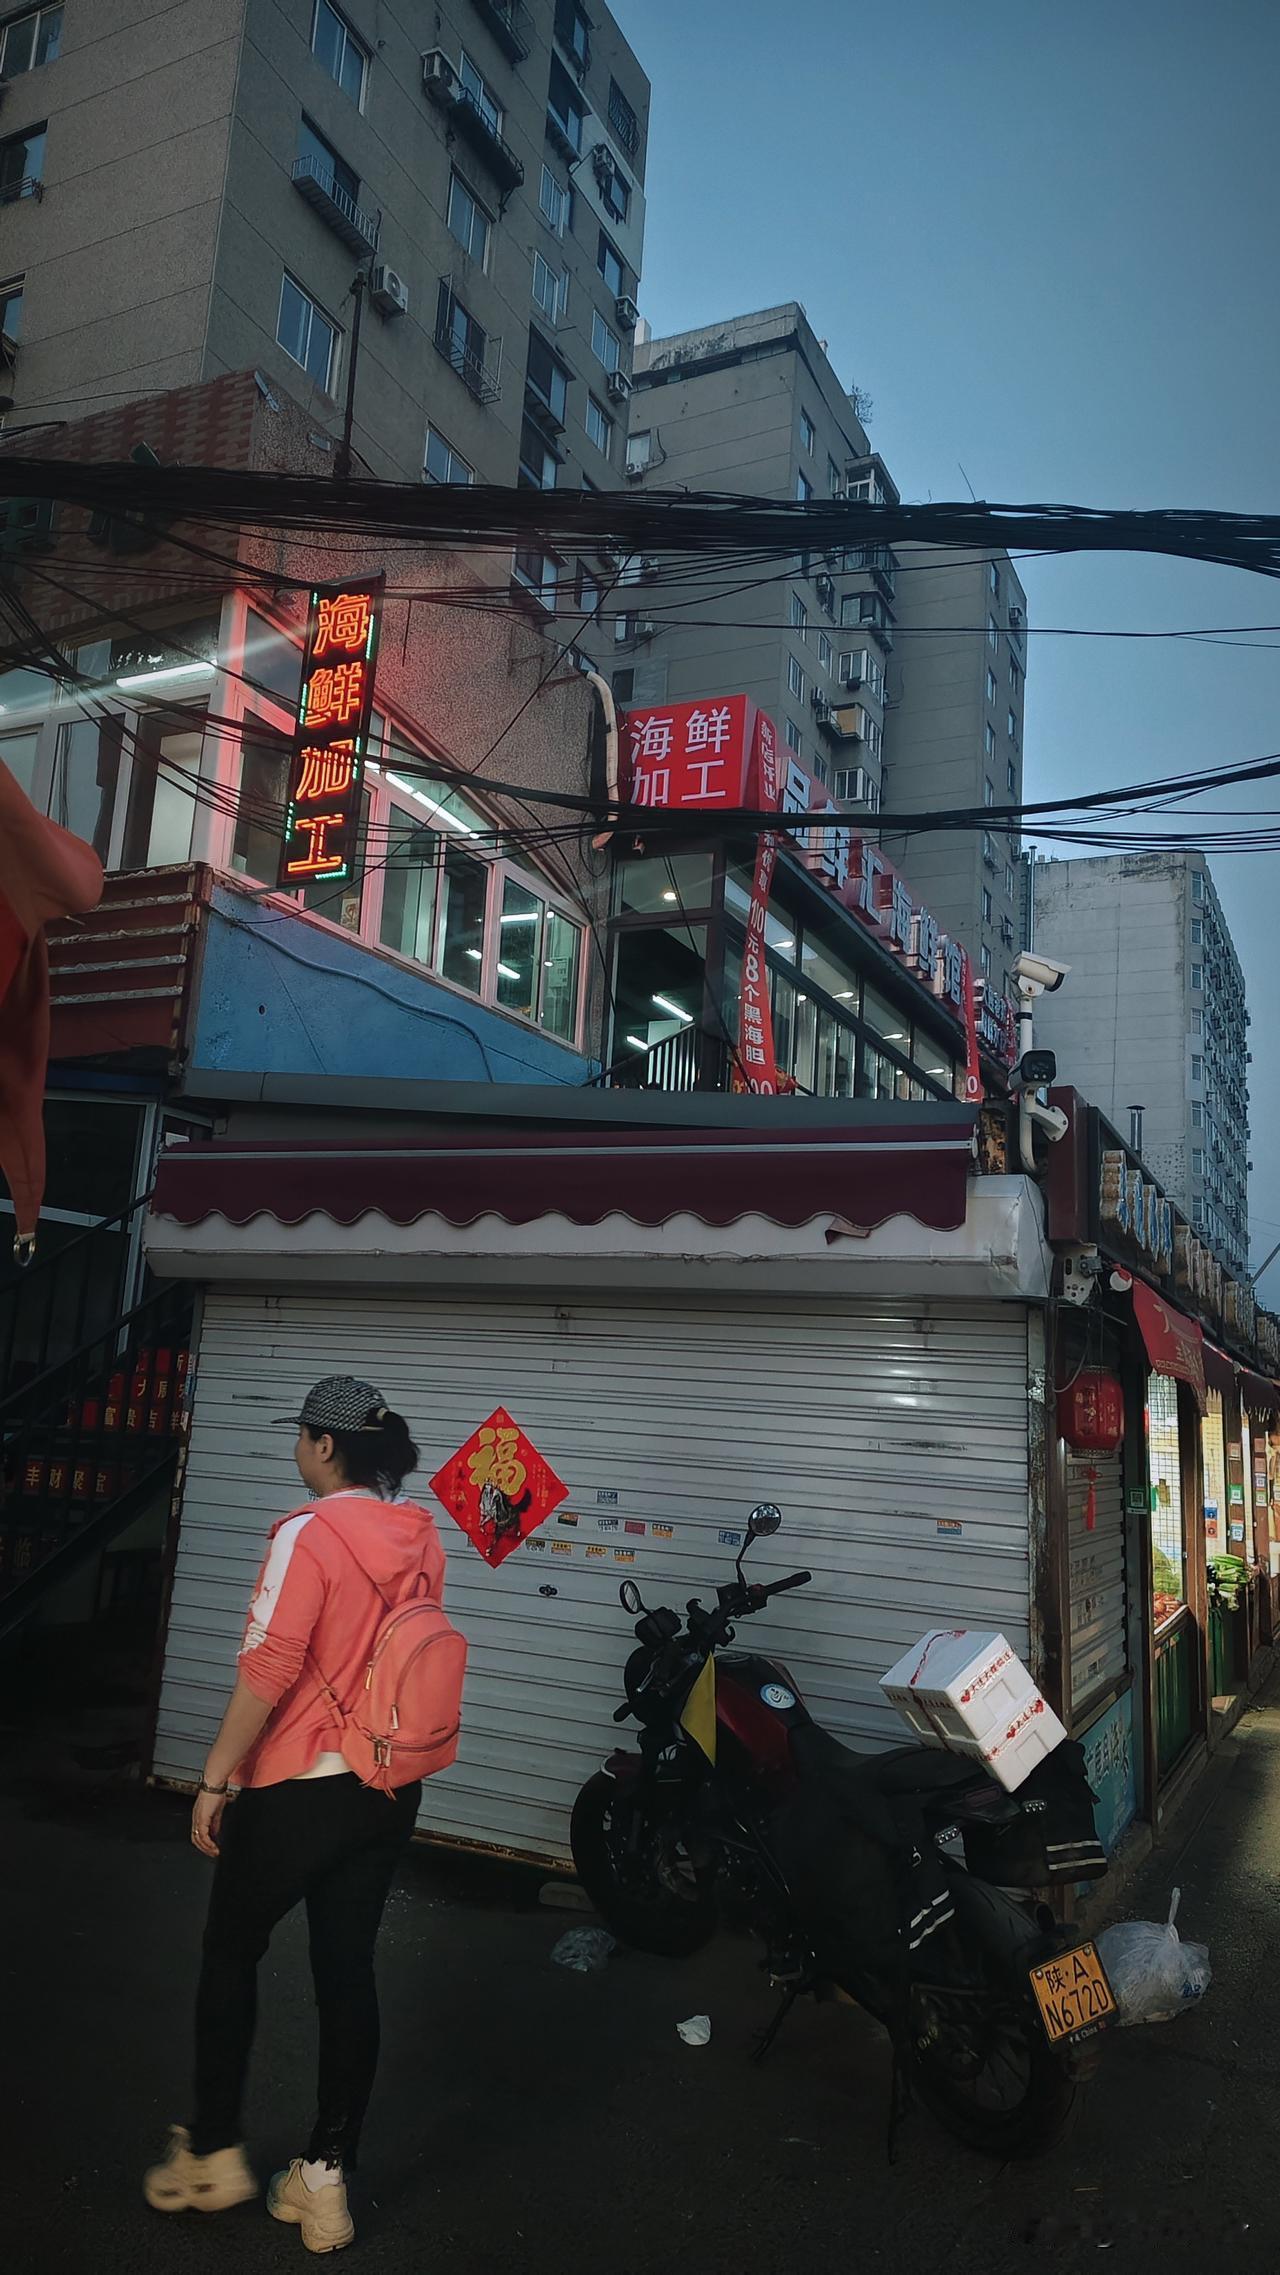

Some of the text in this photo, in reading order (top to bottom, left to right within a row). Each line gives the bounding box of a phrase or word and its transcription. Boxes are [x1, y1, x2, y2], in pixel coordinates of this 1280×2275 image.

[287, 593, 370, 872] 海鲜加工
[630, 706, 731, 764] 海鲜
[630, 760, 726, 807] 加工
[467, 1427, 527, 1496] 福
[1044, 1955, 1089, 1995] 陕·A
[1045, 1979, 1109, 2036] N672D
